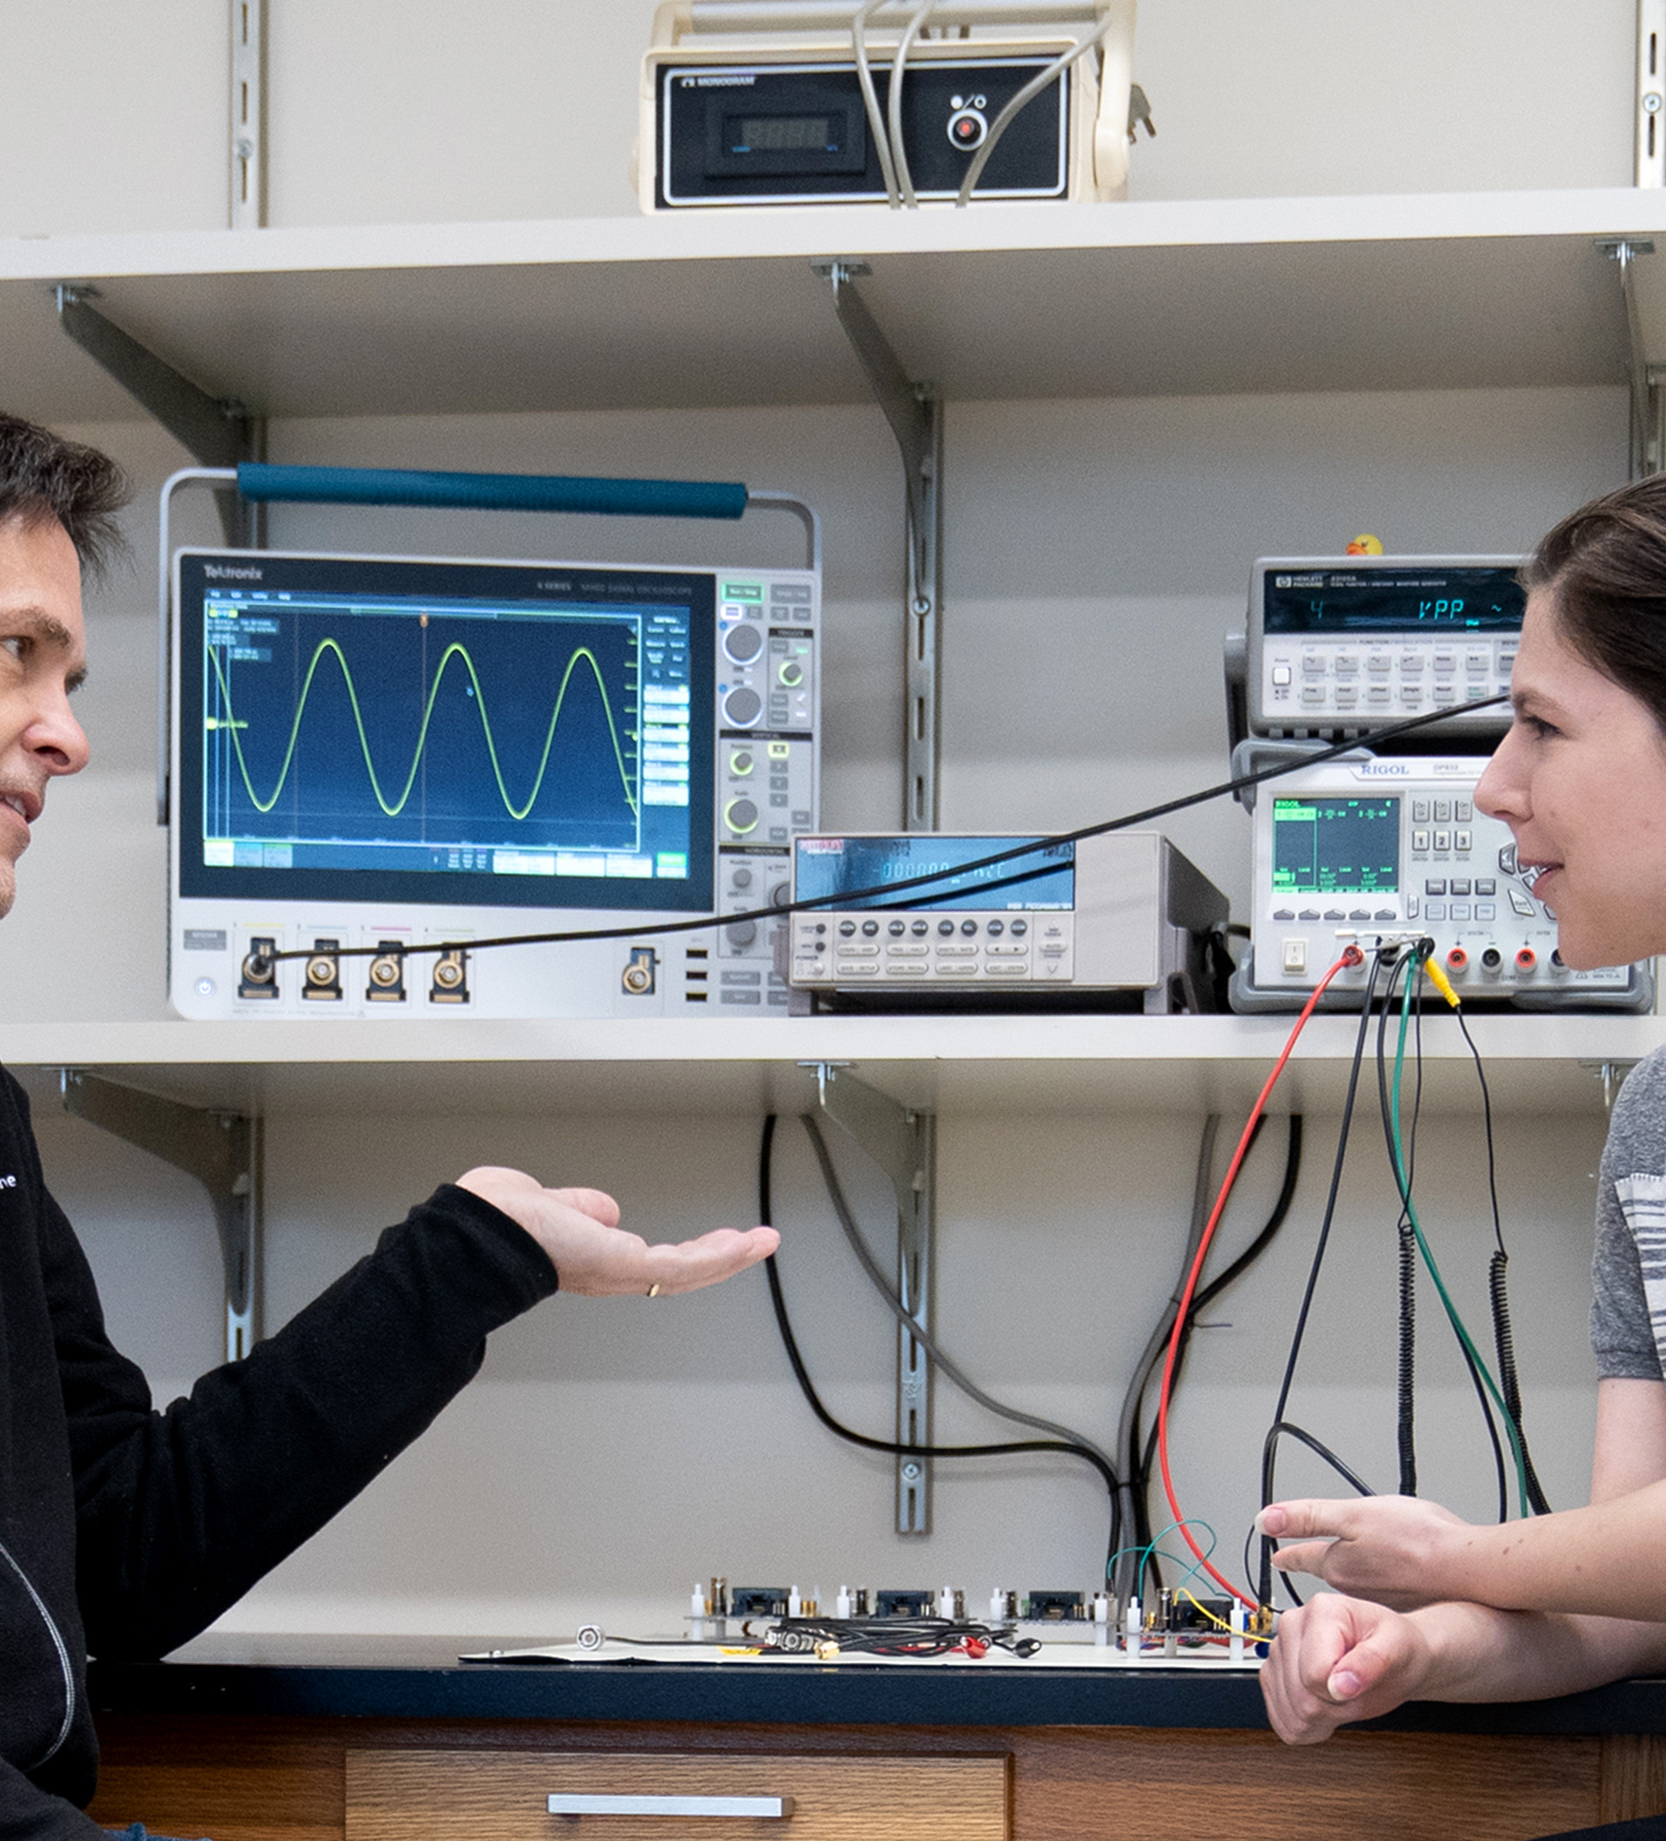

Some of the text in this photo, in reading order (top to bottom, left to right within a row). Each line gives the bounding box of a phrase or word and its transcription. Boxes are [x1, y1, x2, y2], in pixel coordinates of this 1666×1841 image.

[697, 76, 755, 87] MONOGRAM
[203, 564, 263, 581] Tektronix
[1361, 764, 1410, 775] RIGOL
[1418, 836, 1424, 846] 1
[1438, 836, 1446, 846] 2
[1459, 836, 1467, 846] 3
